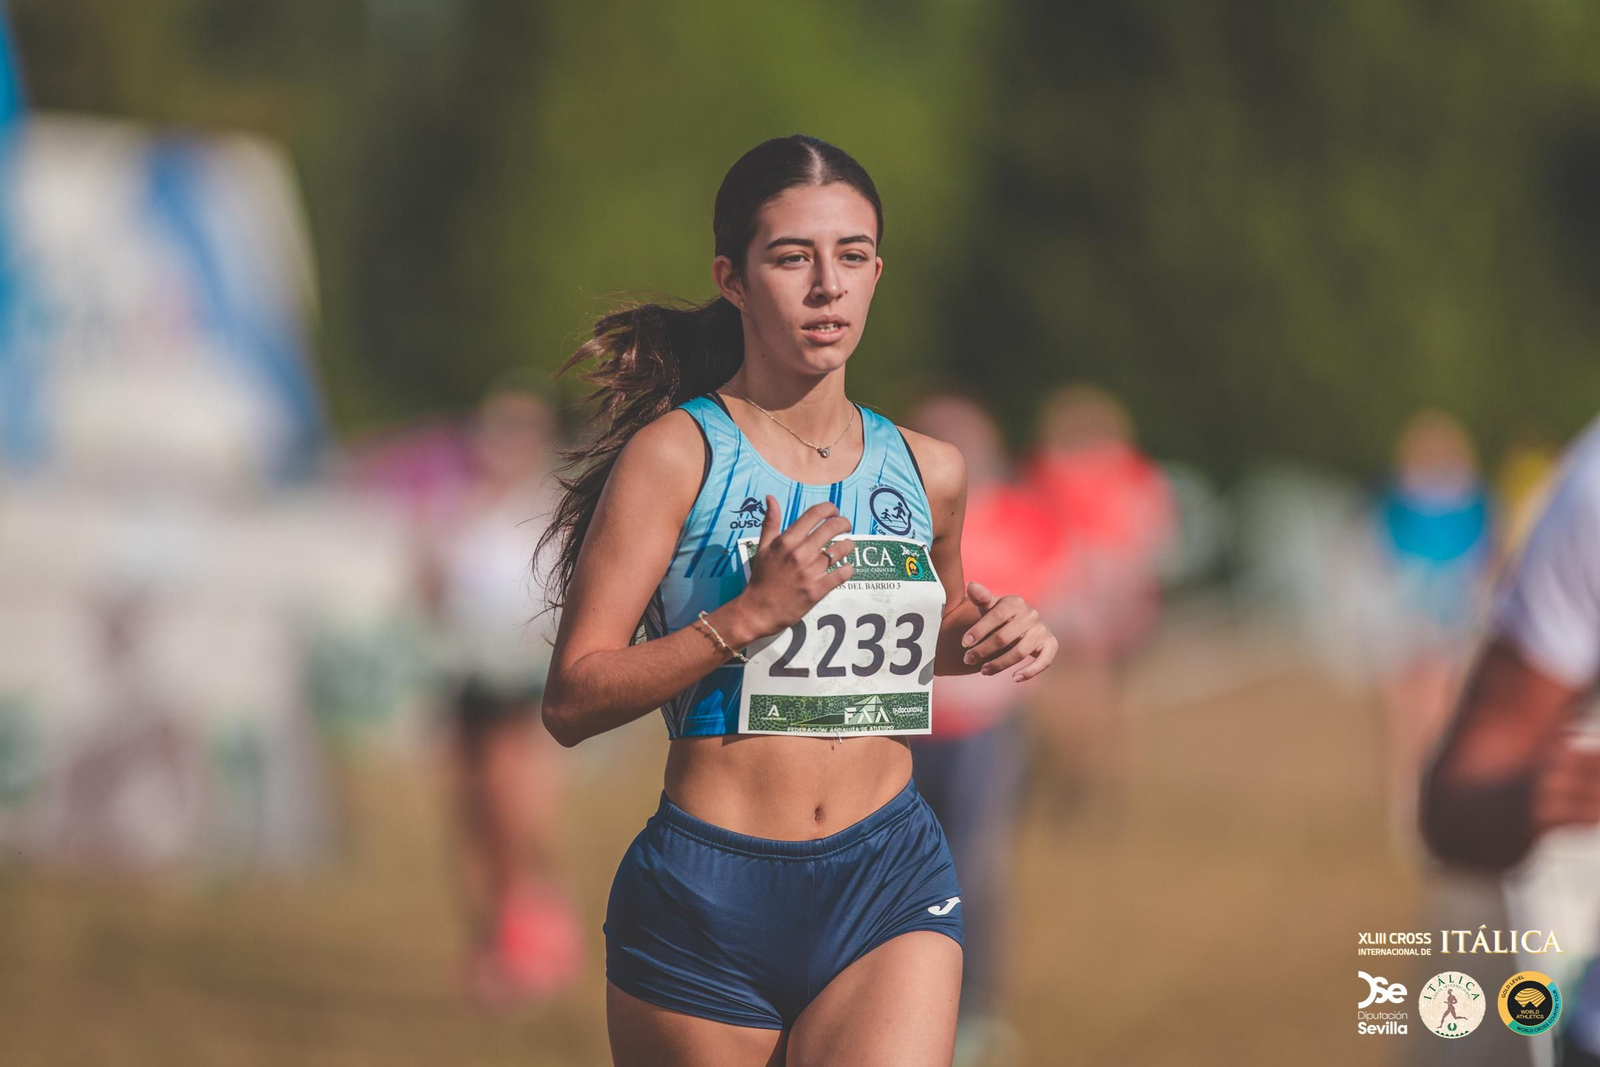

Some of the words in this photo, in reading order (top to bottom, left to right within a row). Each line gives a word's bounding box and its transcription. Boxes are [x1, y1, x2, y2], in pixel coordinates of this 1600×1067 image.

[730, 520, 762, 529] aust
[865, 582, 895, 590] BARRIO
[896, 582, 901, 590] 3
[769, 612, 925, 678] 2233
